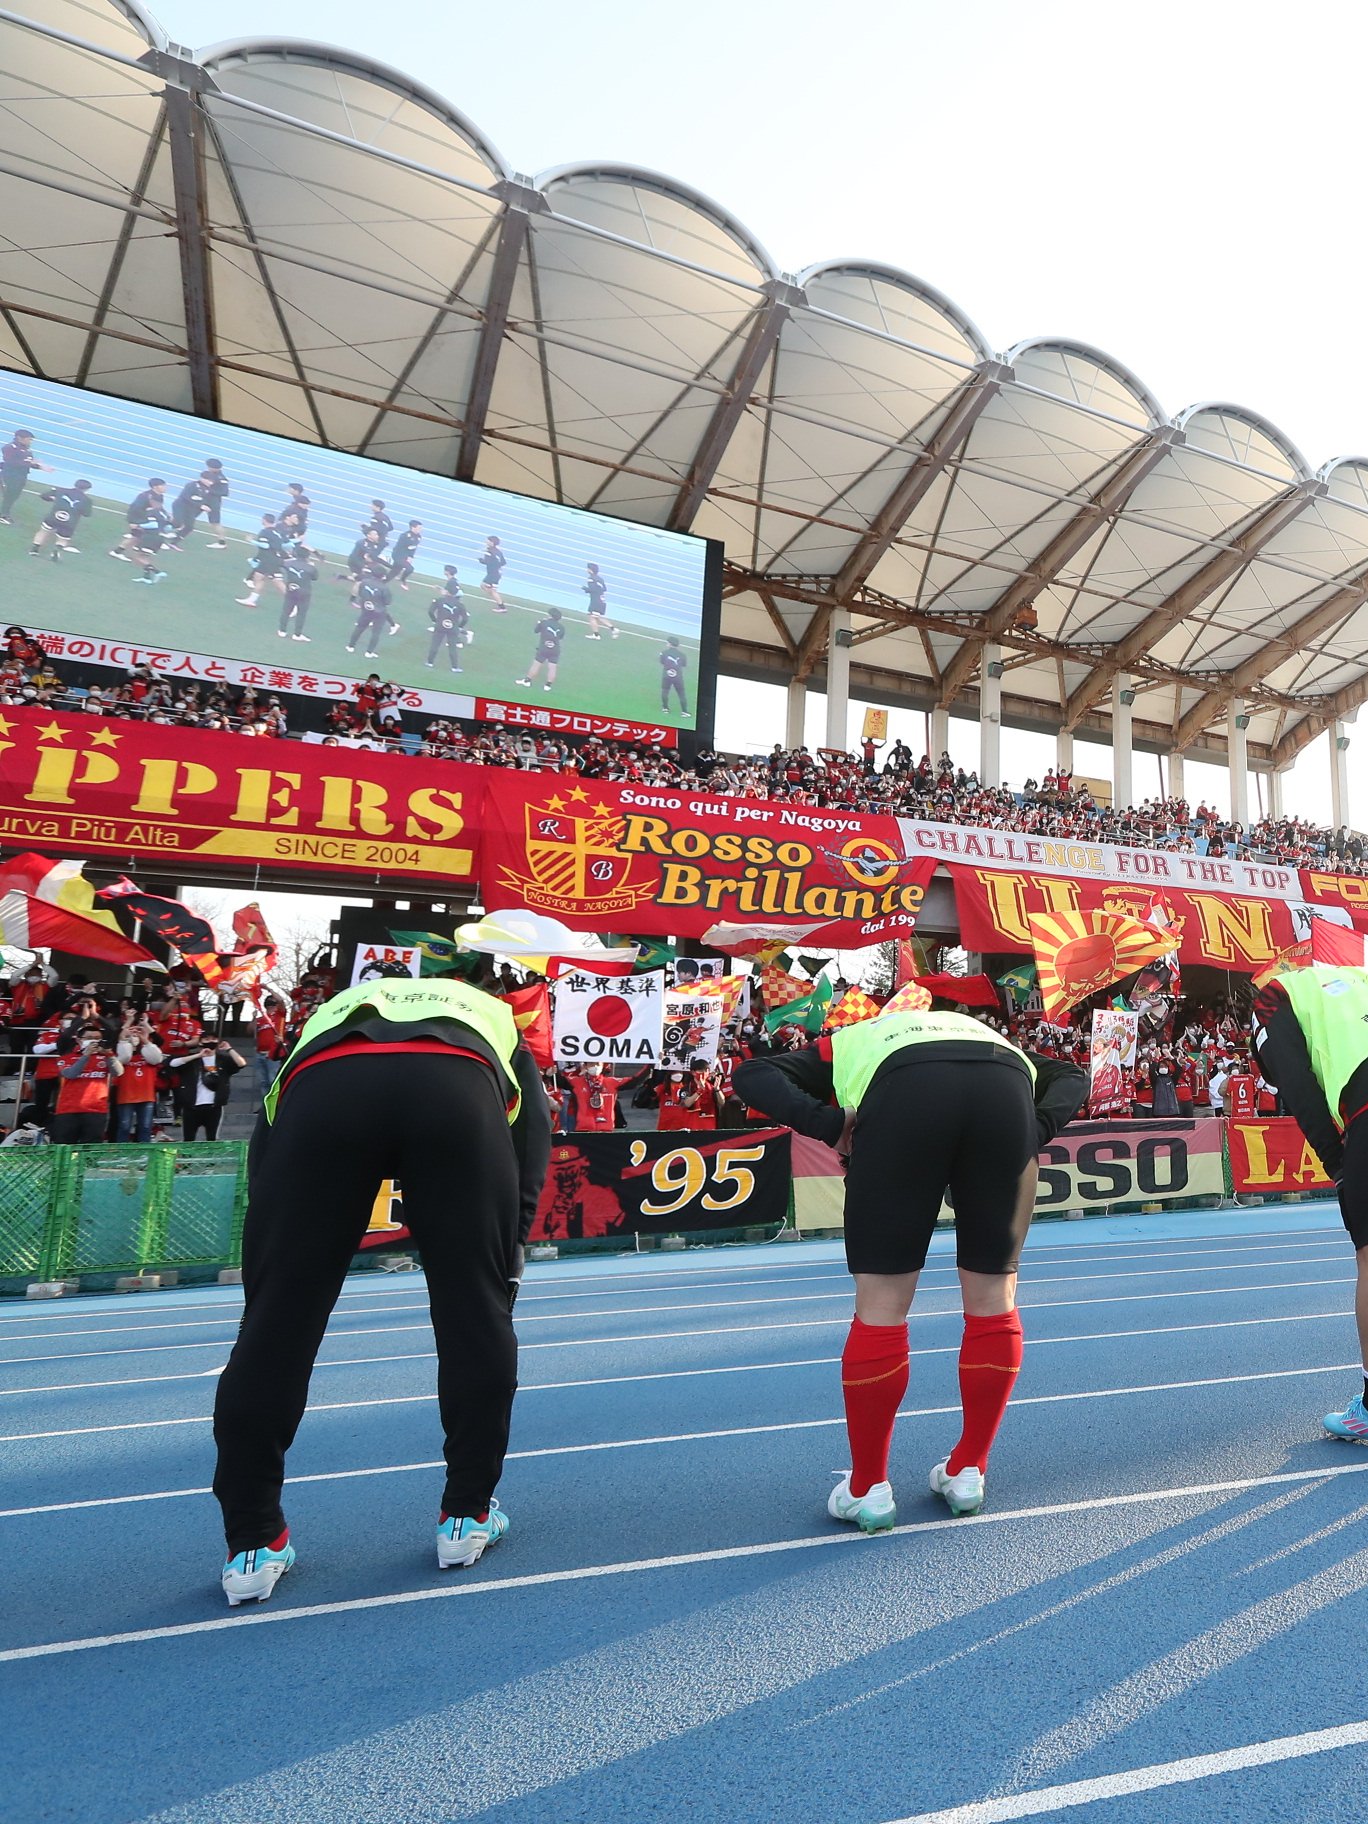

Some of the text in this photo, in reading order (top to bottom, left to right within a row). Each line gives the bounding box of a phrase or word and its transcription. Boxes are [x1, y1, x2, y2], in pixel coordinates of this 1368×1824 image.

[0, 633, 423, 708] 端のICTで人と 企業をつる
[485, 702, 668, 744] 富士通フロンテック
[0, 740, 465, 841] PPERS
[619, 789, 863, 833] Sono qui per Nagoya
[125, 825, 179, 847] Alta
[618, 812, 814, 868] Rosso
[274, 837, 421, 865] SINCE 2004
[914, 827, 1290, 891] CHALLENGE FOR THE TOP
[528, 891, 632, 912] NOSTRA NAGOYA
[655, 861, 925, 921] Brillante
[860, 919, 886, 934] dal
[363, 946, 414, 964] ABE
[564, 974, 659, 998] 世界基準
[560, 1034, 655, 1060] SOMA
[664, 1027, 684, 1044] 6
[1238, 1083, 1247, 1099] 6
